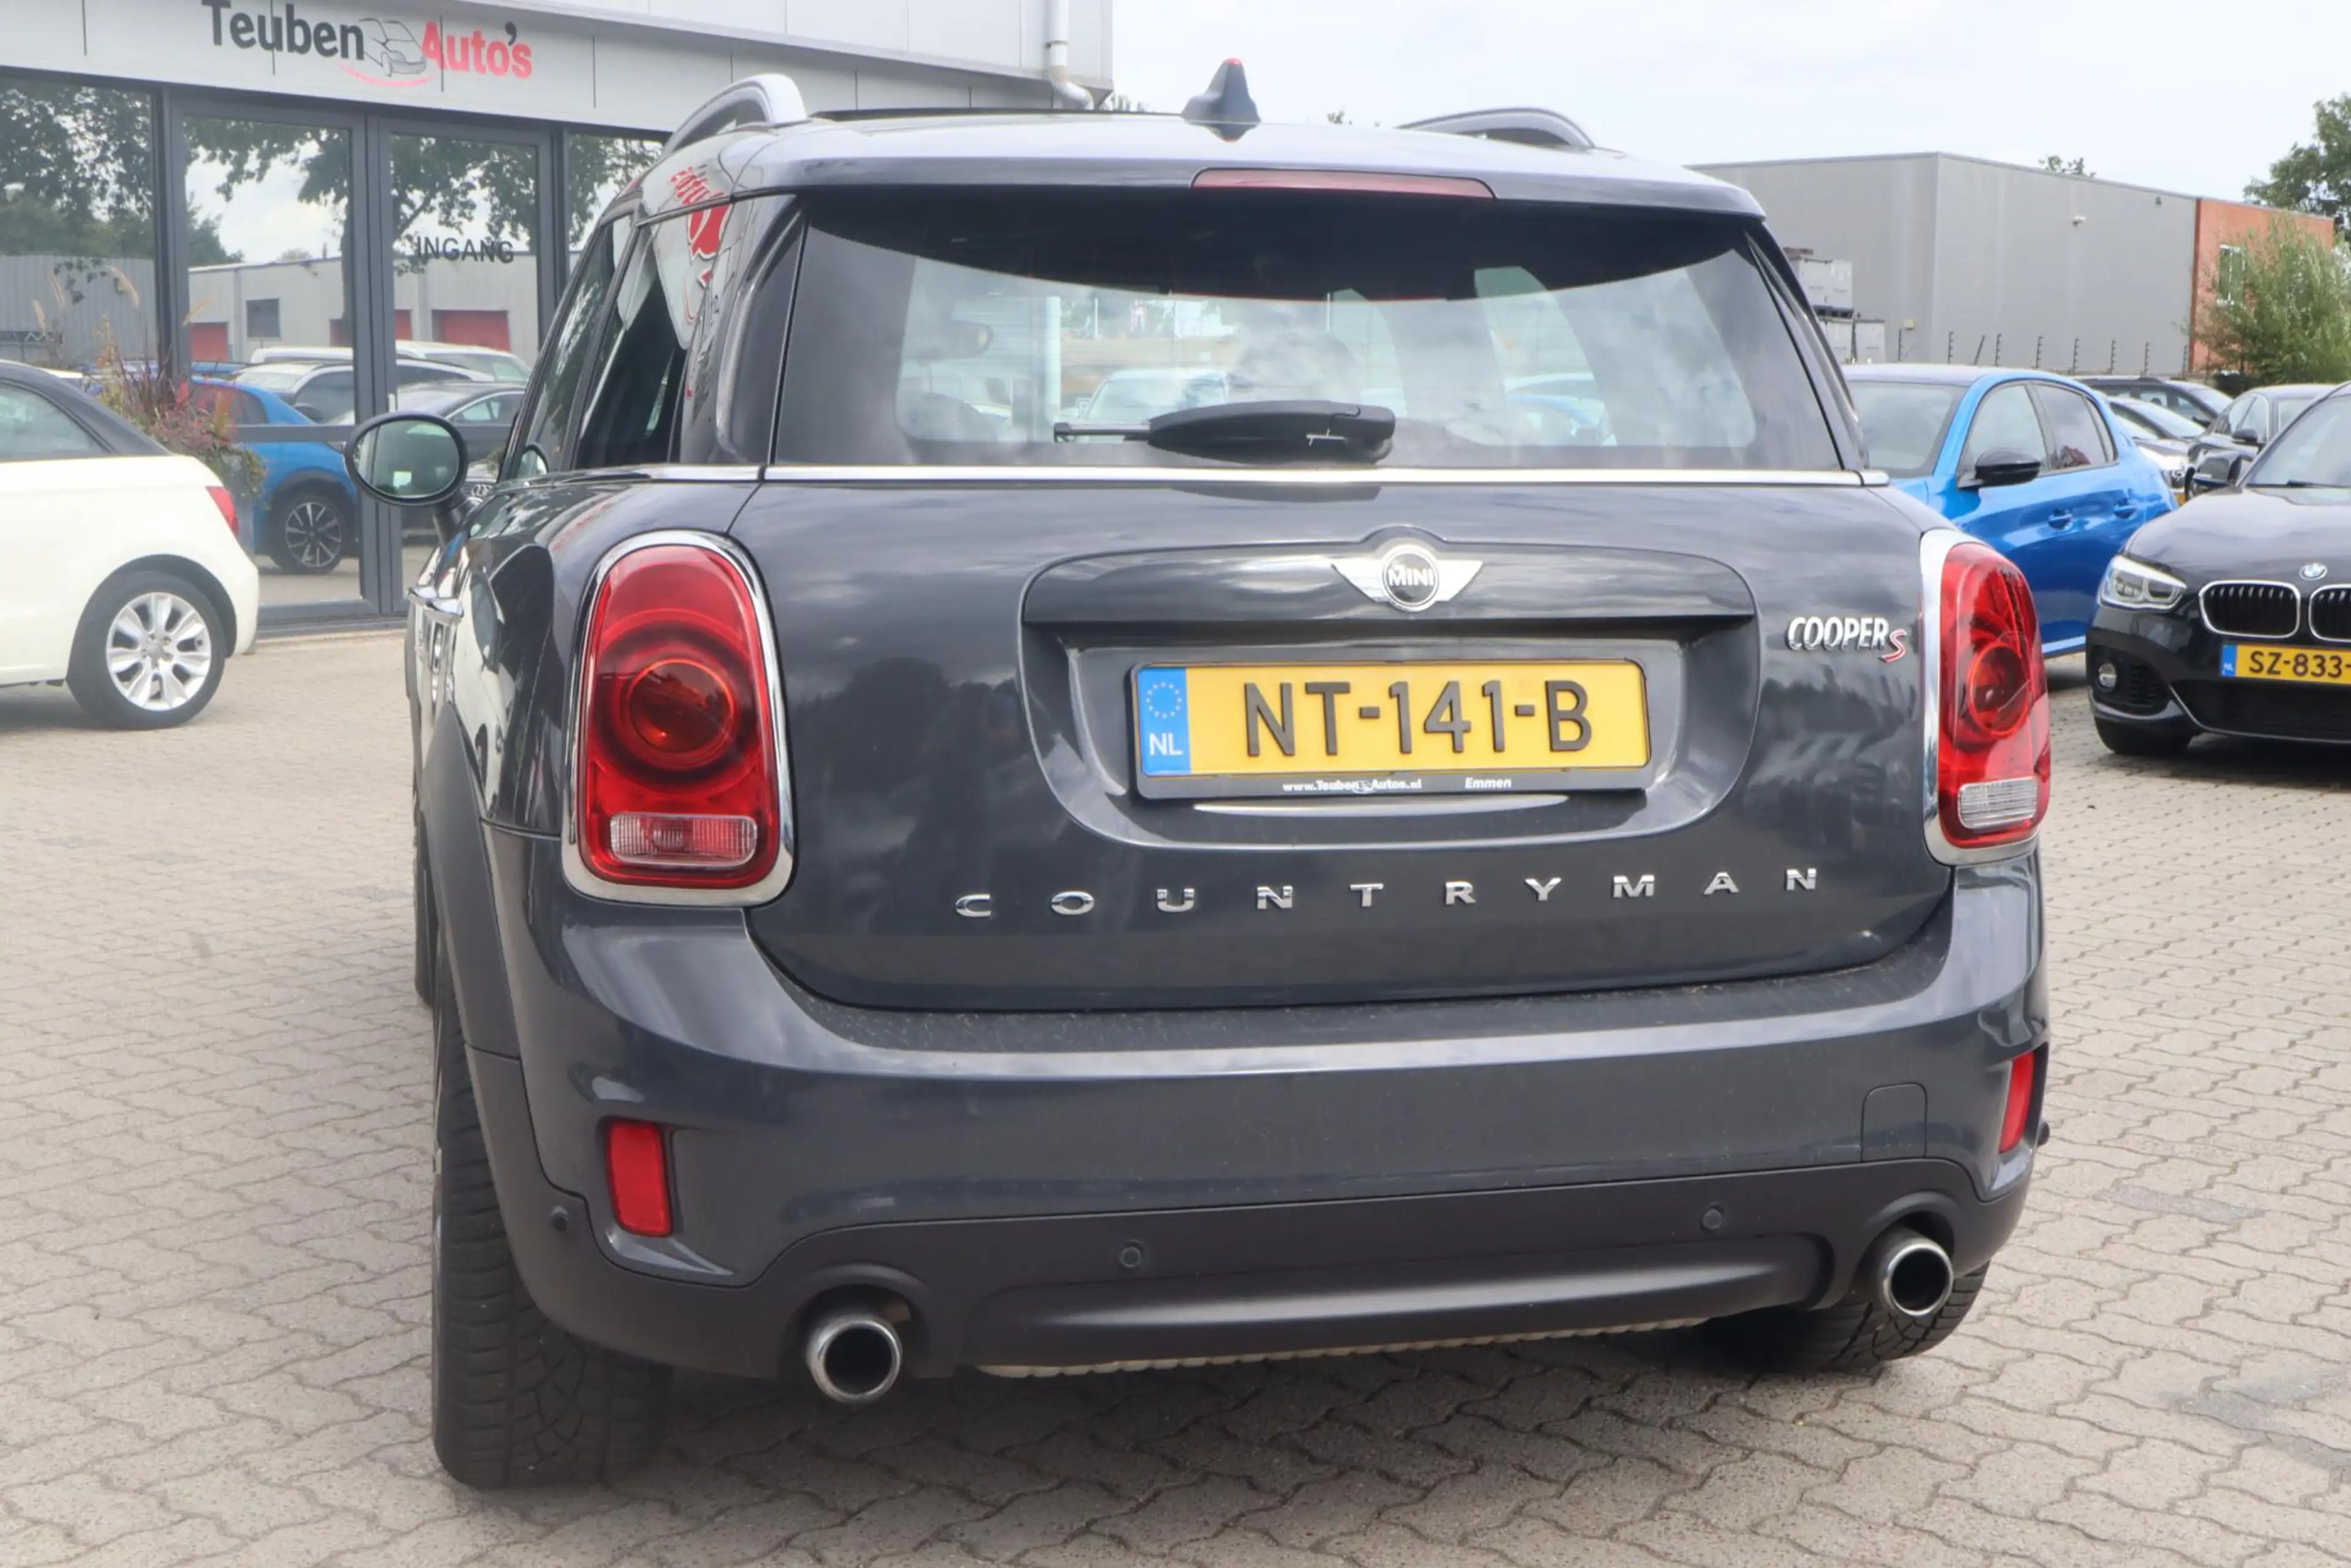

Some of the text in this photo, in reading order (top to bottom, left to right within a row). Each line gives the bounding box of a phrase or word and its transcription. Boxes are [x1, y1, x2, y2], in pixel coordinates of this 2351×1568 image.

[201, 0, 366, 61] Teuben
[417, 235, 515, 264] INGANG
[1387, 566, 1435, 587] MINI
[1786, 615, 1908, 663] COOPER S
[1243, 679, 1592, 757] NT-141-B
[1149, 732, 1184, 756] NL
[1465, 776, 1512, 790] Emmen
[954, 868, 1819, 919] COUNTRYMAN
